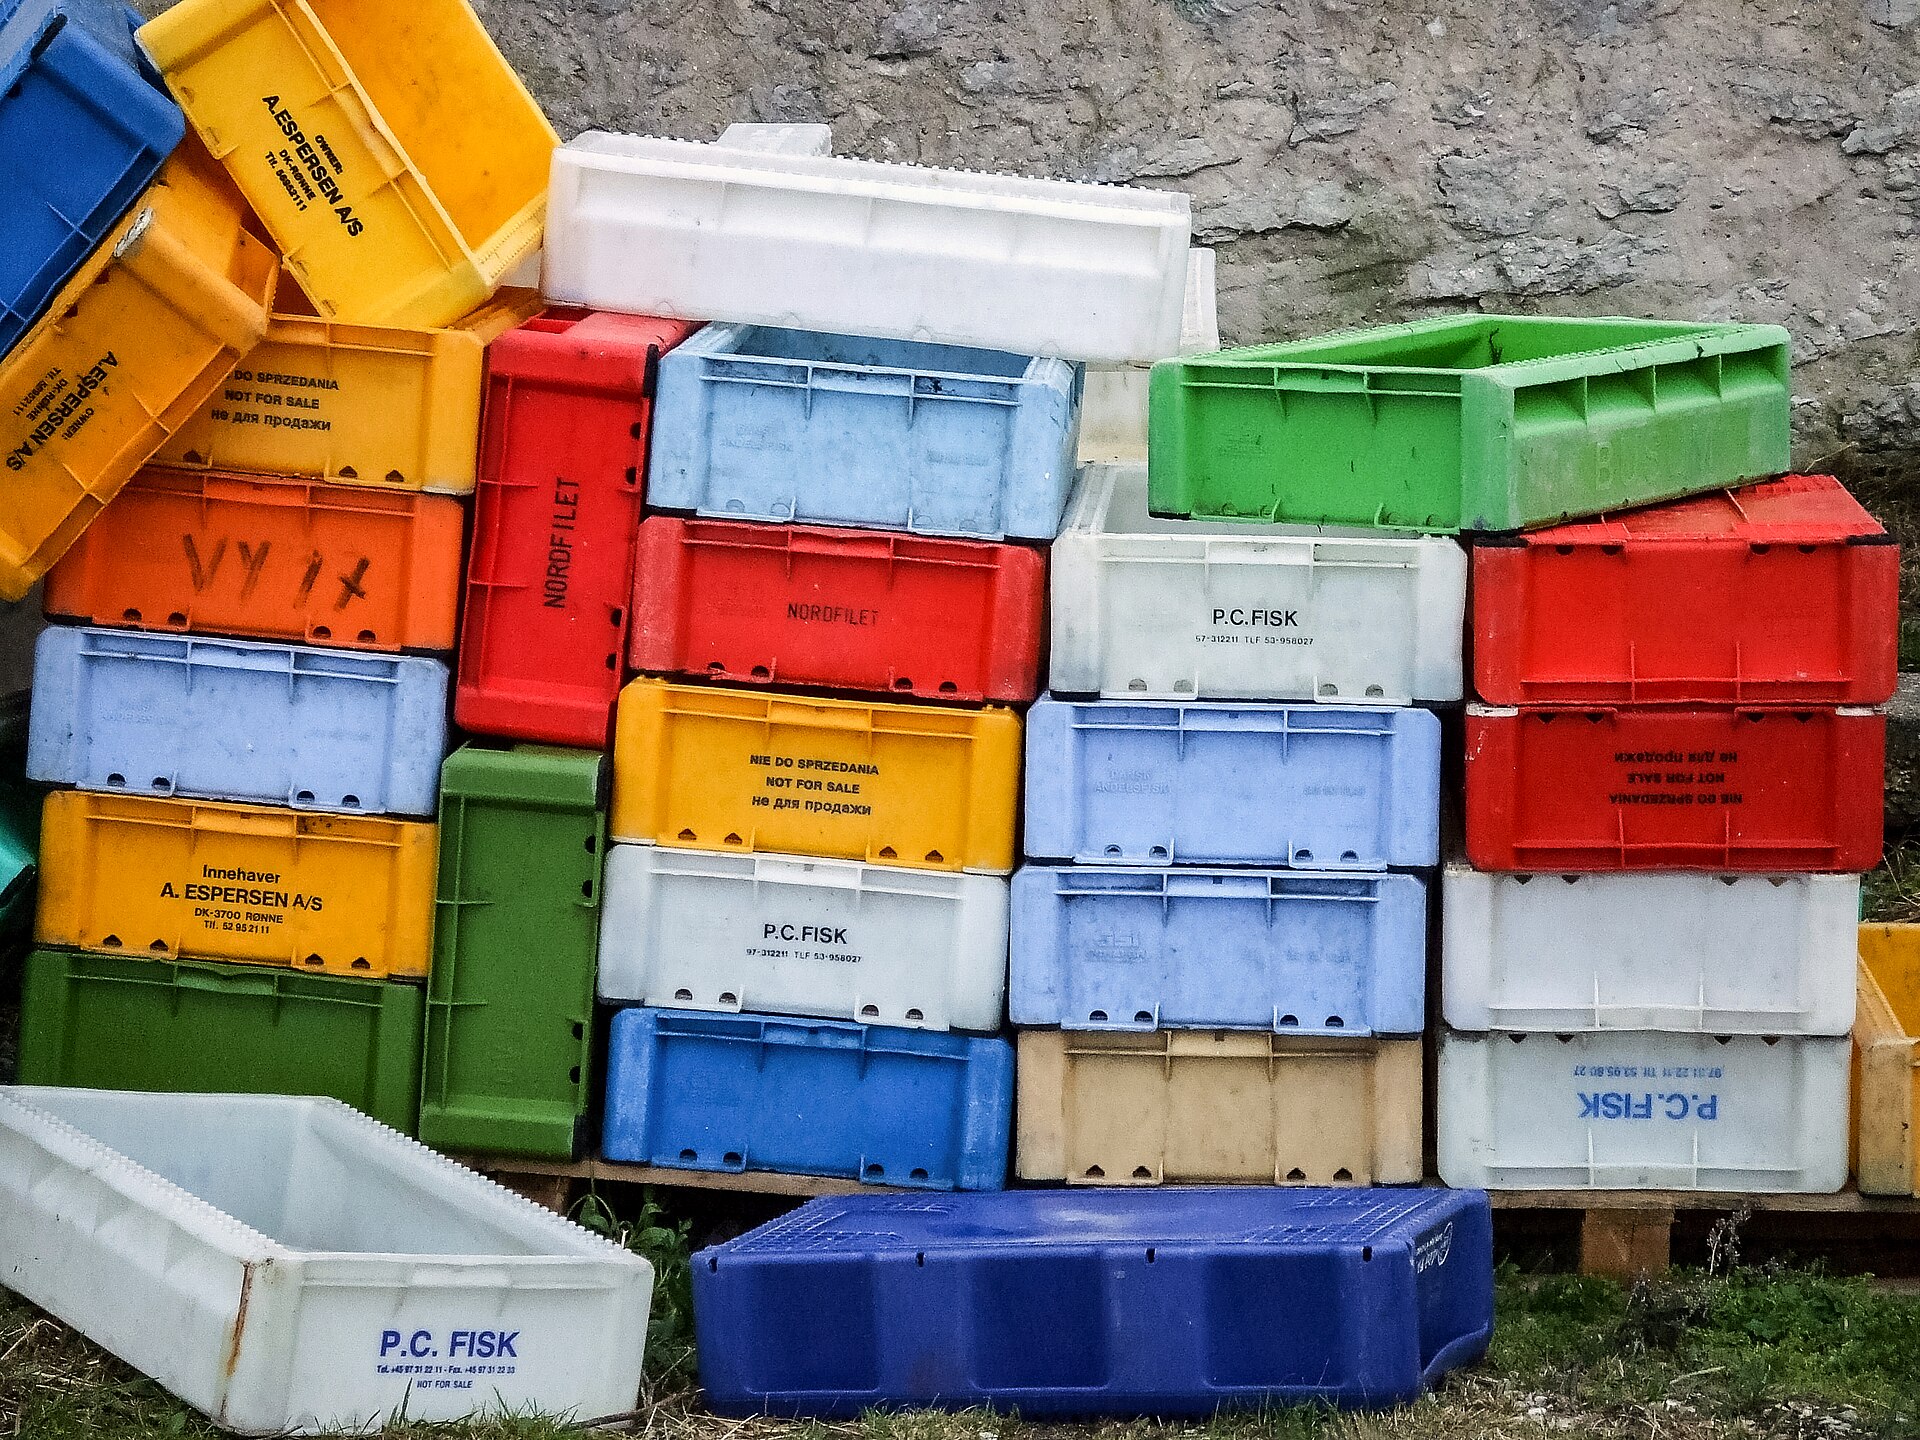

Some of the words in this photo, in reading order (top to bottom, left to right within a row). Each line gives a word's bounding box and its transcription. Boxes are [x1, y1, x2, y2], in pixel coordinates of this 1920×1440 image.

[314, 135, 343, 175] OWNER:
[334, 206, 364, 237] A/S
[233, 370, 253, 382] DO
[256, 372, 340, 391] SPRZEDANIA
[224, 389, 252, 402] NOT
[255, 393, 282, 406] FOR
[286, 396, 320, 410] SALE
[61, 407, 95, 440] OWNER:
[211, 409, 229, 421] не
[232, 411, 259, 424] для
[264, 414, 332, 431] продажи
[6, 441, 34, 471] A/S
[543, 476, 579, 609] NORDFILET
[786, 602, 880, 626] NORDFILET
[1245, 636, 1261, 644] TLF
[750, 754, 771, 766] NIE
[775, 756, 794, 768] DO
[797, 758, 880, 776] SPRZEDANIA
[1614, 749, 1684, 763] продажи
[1687, 750, 1716, 763] для
[1719, 751, 1738, 763] не
[766, 776, 793, 788] NOT
[796, 779, 823, 791] FOR
[826, 781, 860, 795] SALE
[1627, 772, 1662, 783] SALE
[1665, 772, 1694, 783] FOR
[1697, 773, 1725, 783] NOT
[751, 796, 770, 807] не
[773, 797, 800, 811] для
[804, 799, 872, 816] продажи
[1609, 793, 1694, 805] SPRZEDANIA
[1697, 793, 1717, 804] DO
[1720, 793, 1743, 804] NIE
[202, 864, 281, 884] Innehaver
[160, 882, 180, 899] A.
[184, 884, 289, 908] ESPERSEN
[291, 893, 324, 912] A/S
[194, 907, 242, 921] DK-3700
[245, 911, 284, 924] RØNNE
[794, 951, 811, 960] TLF
[449, 1330, 520, 1358] FISK
[416, 1380, 433, 1389] NOT
[435, 1380, 451, 1389] FOR
[453, 1380, 474, 1389] SALE
